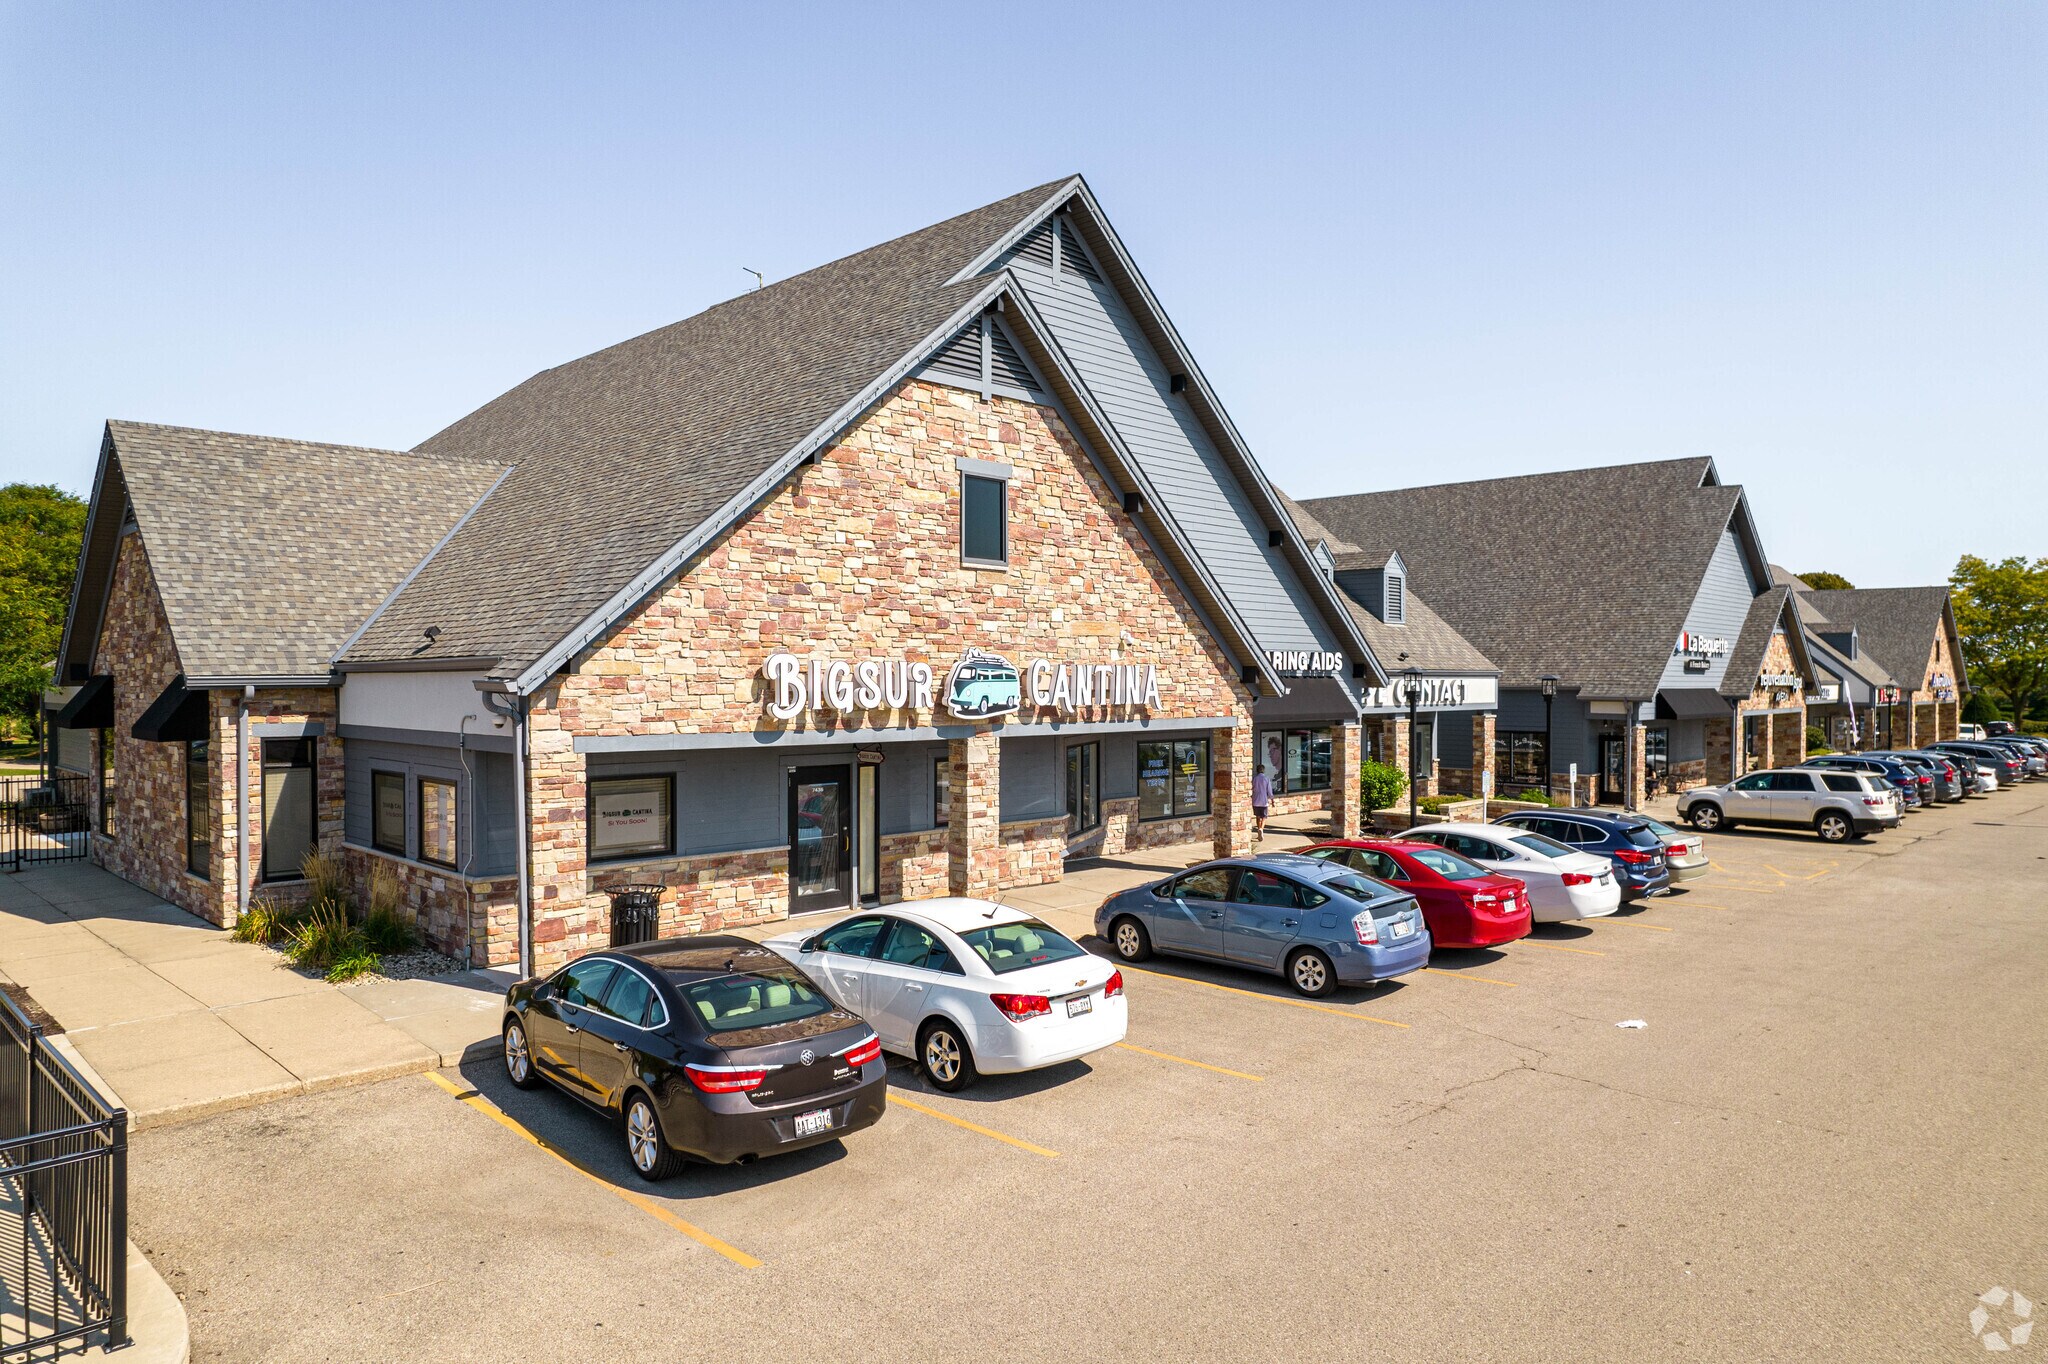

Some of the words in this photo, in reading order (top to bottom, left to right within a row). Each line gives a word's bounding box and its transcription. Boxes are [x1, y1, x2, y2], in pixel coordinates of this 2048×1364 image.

[1689, 633, 1698, 652] La
[1698, 635, 1729, 657] Baguette
[1311, 651, 1343, 671] AIDS
[762, 653, 935, 720] BIGSUR
[1028, 658, 1163, 711] CANTINA
[632, 808, 652, 816] CANTINA
